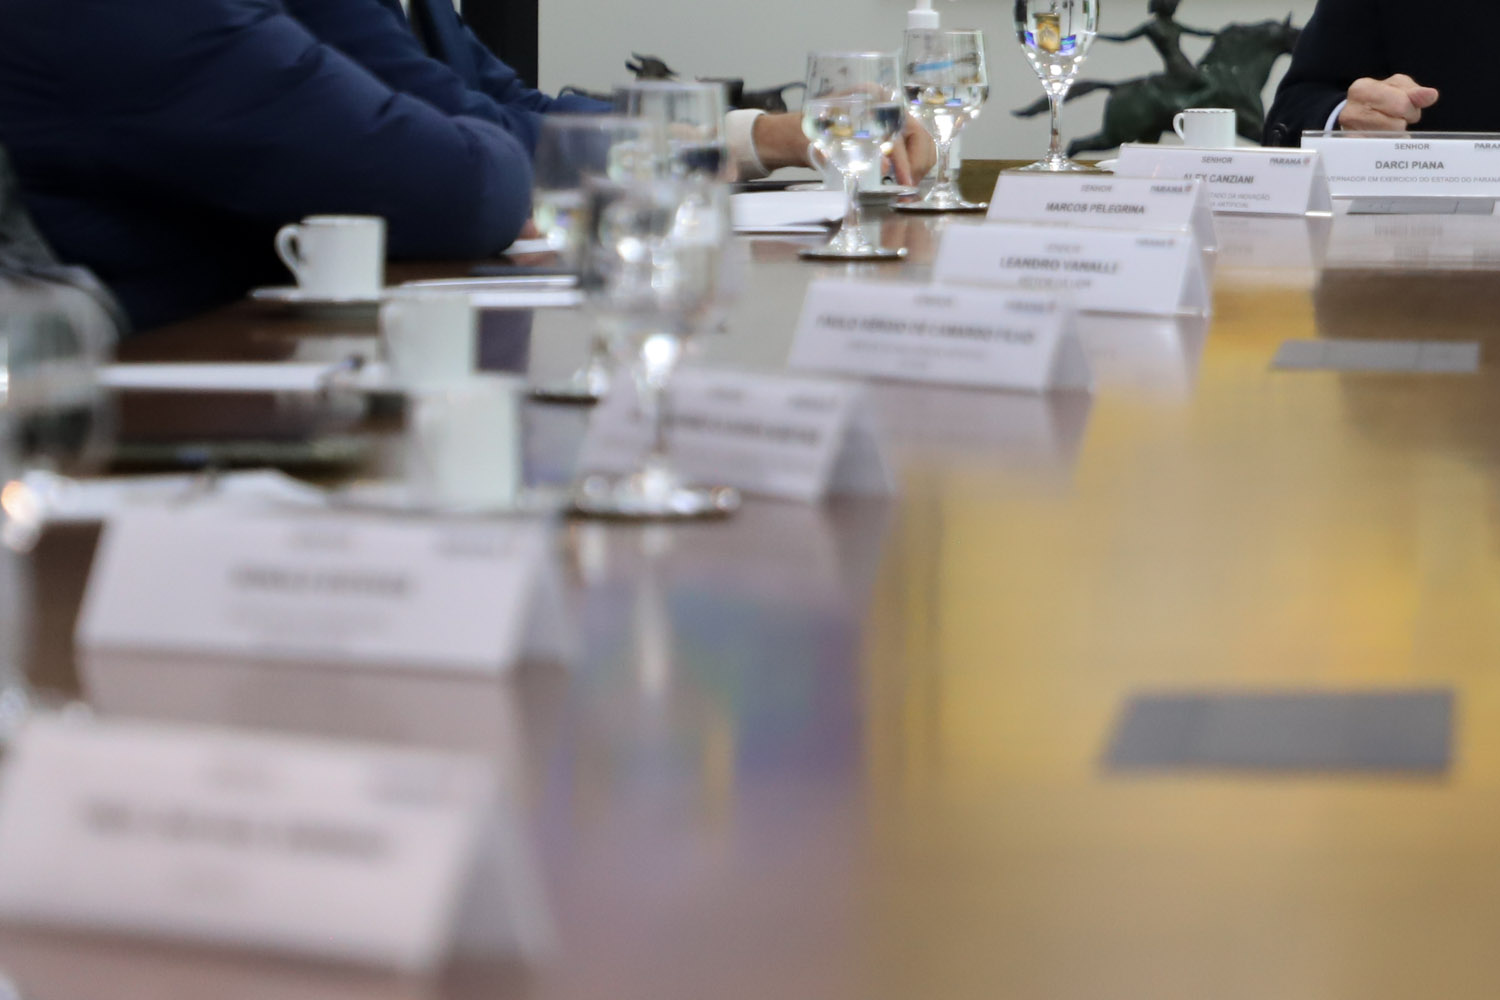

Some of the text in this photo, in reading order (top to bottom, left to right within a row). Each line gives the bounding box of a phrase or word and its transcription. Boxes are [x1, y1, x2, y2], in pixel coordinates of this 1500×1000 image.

[1393, 142, 1430, 151] SENHOR
[1200, 156, 1233, 164] SENHOR
[1375, 160, 1445, 170] DARCI PIANA
[1209, 174, 1254, 184] CANZIANI
[1045, 202, 1145, 214] MARCOS PELEGRINA
